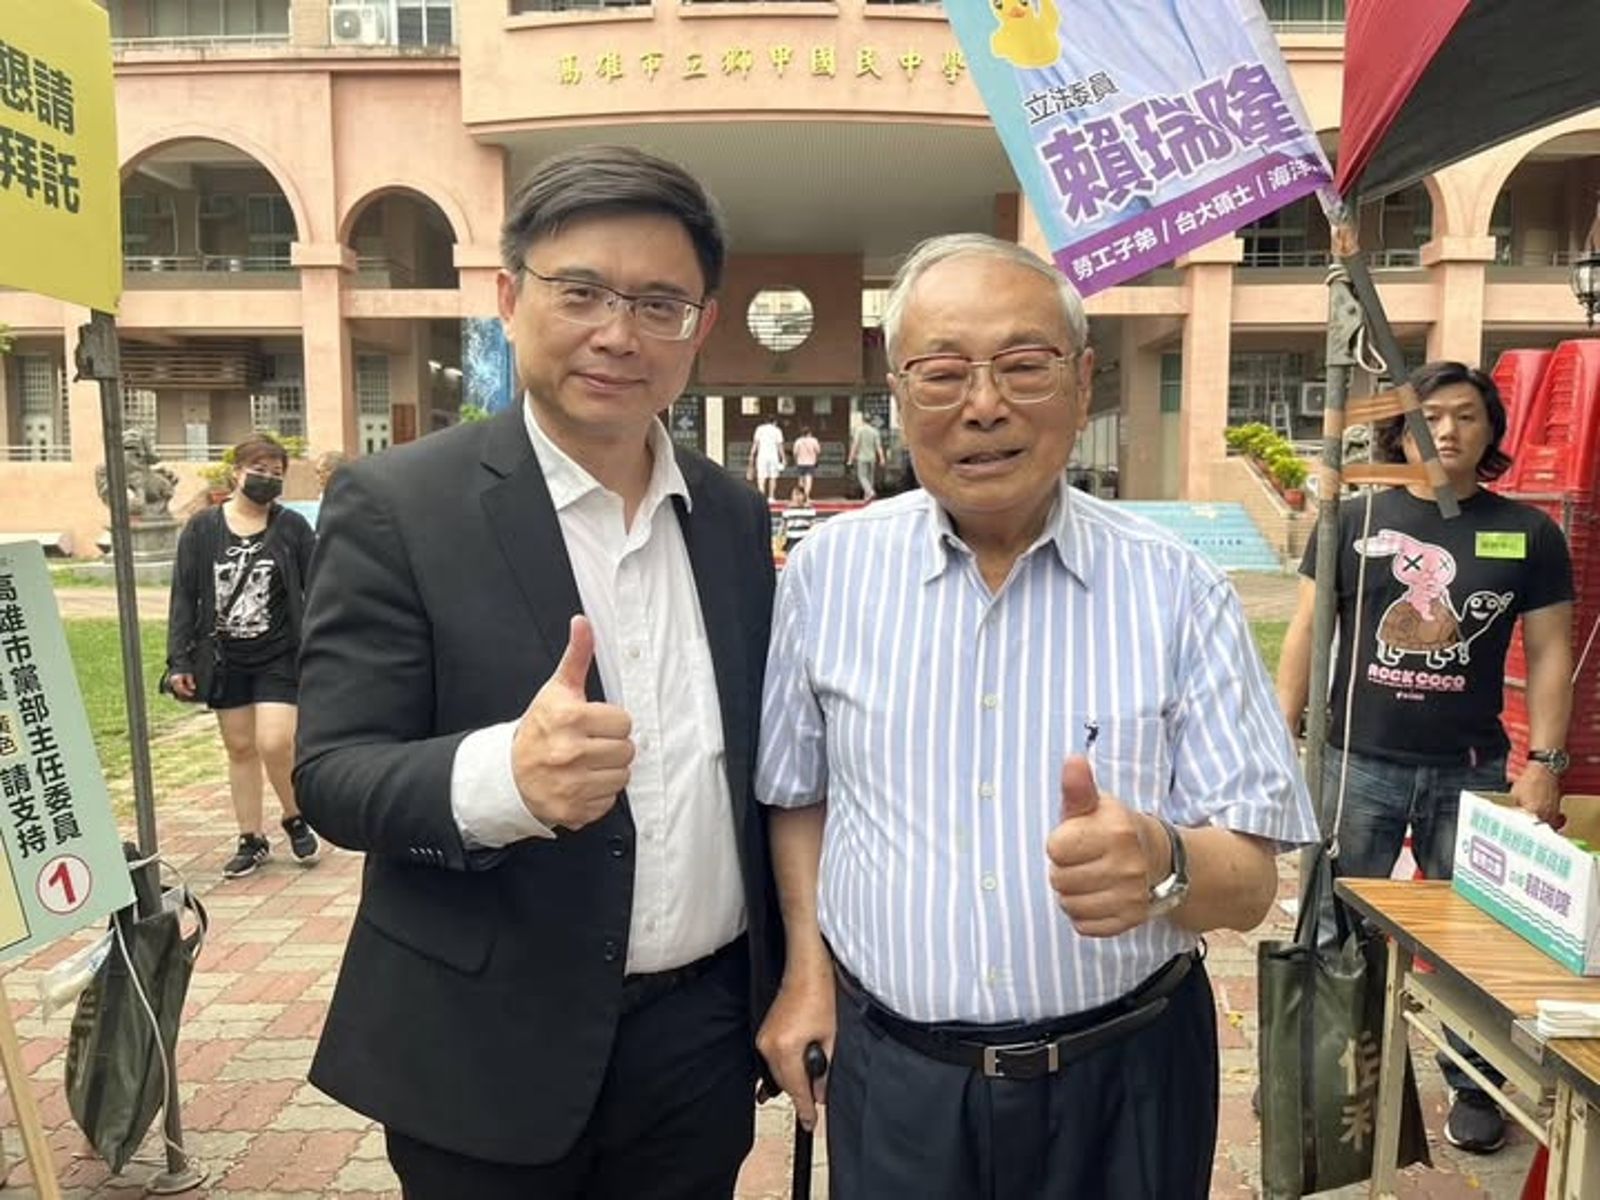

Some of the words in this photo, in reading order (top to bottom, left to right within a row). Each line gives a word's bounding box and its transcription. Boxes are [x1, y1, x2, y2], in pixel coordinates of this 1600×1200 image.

[557, 44, 967, 85] 高雄市立獅甲國民中學
[1024, 72, 1119, 124] 立法委員
[1042, 63, 1302, 222] 賴瑞隆
[0, 125, 80, 214] 拜託
[1267, 158, 1318, 191] 海洋
[0, 763, 47, 860] 請支持
[48, 861, 77, 905] 1
